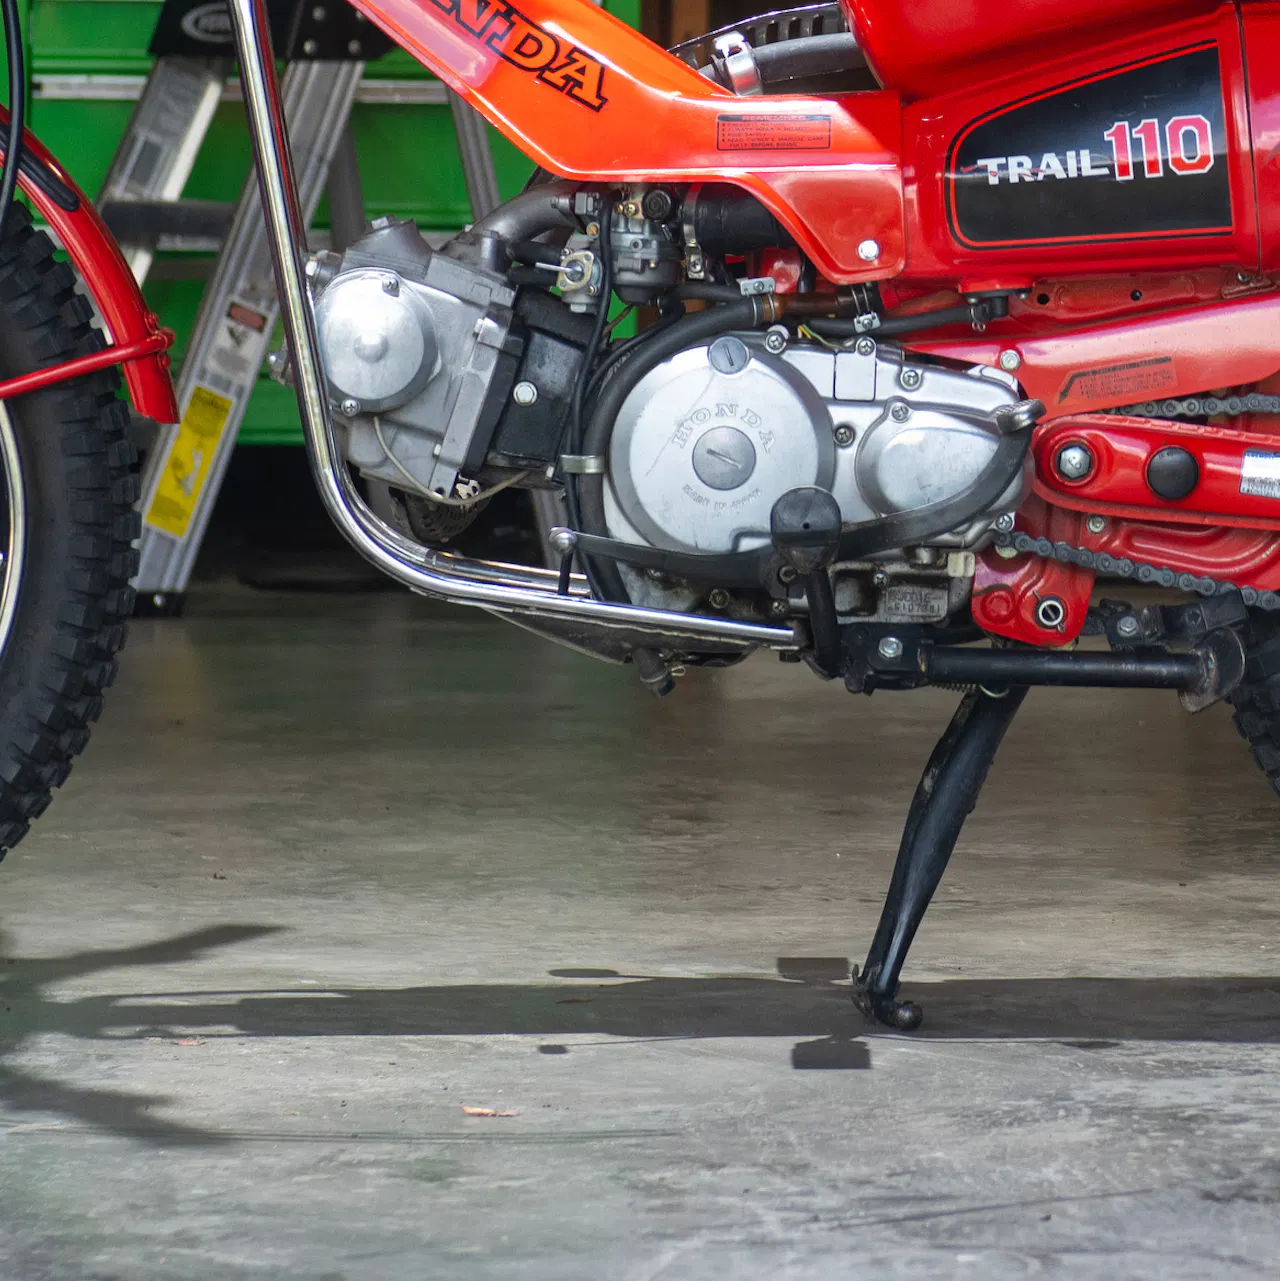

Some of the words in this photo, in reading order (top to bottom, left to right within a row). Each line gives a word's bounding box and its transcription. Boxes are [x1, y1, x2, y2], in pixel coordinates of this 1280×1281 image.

[977, 148, 1109, 186] TRAIL
[1104, 114, 1215, 181] 110
[672, 403, 776, 454] HONDA
